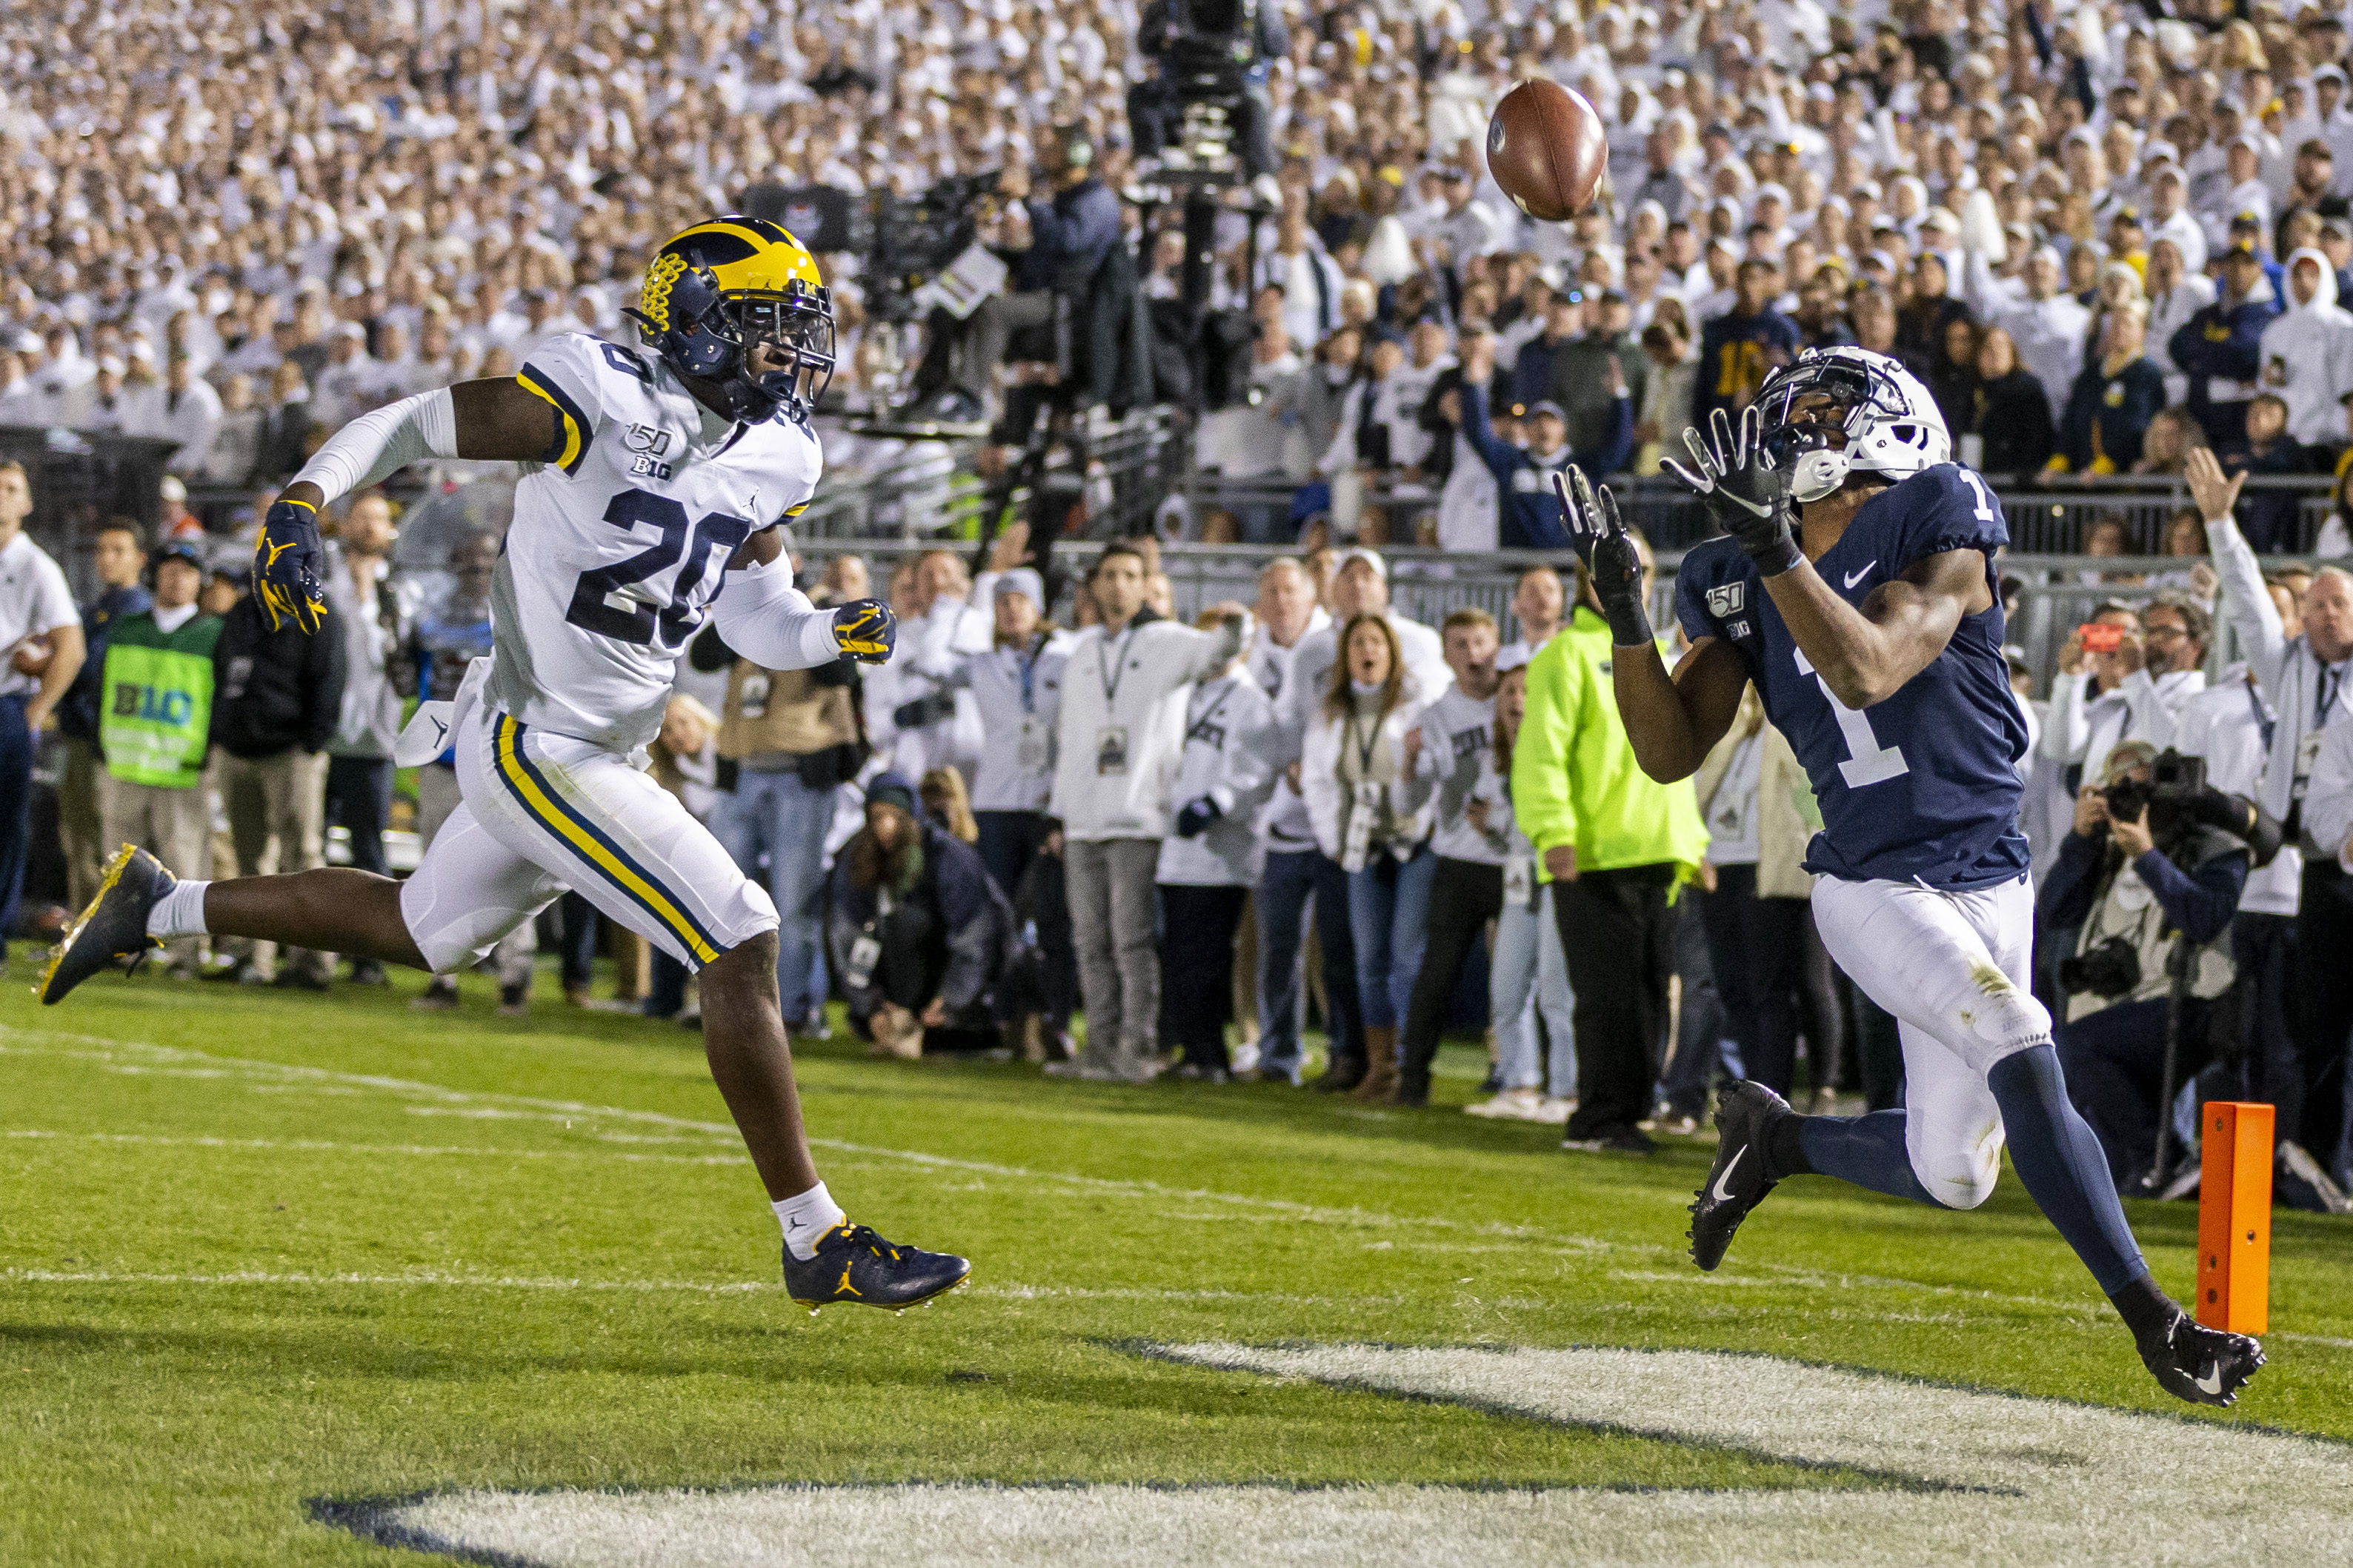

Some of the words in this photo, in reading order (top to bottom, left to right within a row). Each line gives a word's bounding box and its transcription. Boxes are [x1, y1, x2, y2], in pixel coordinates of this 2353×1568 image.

[1959, 468, 1994, 522] 1
[565, 487, 752, 649] 20
[1705, 581, 1745, 618] 150
[1793, 646, 1909, 789] 1
